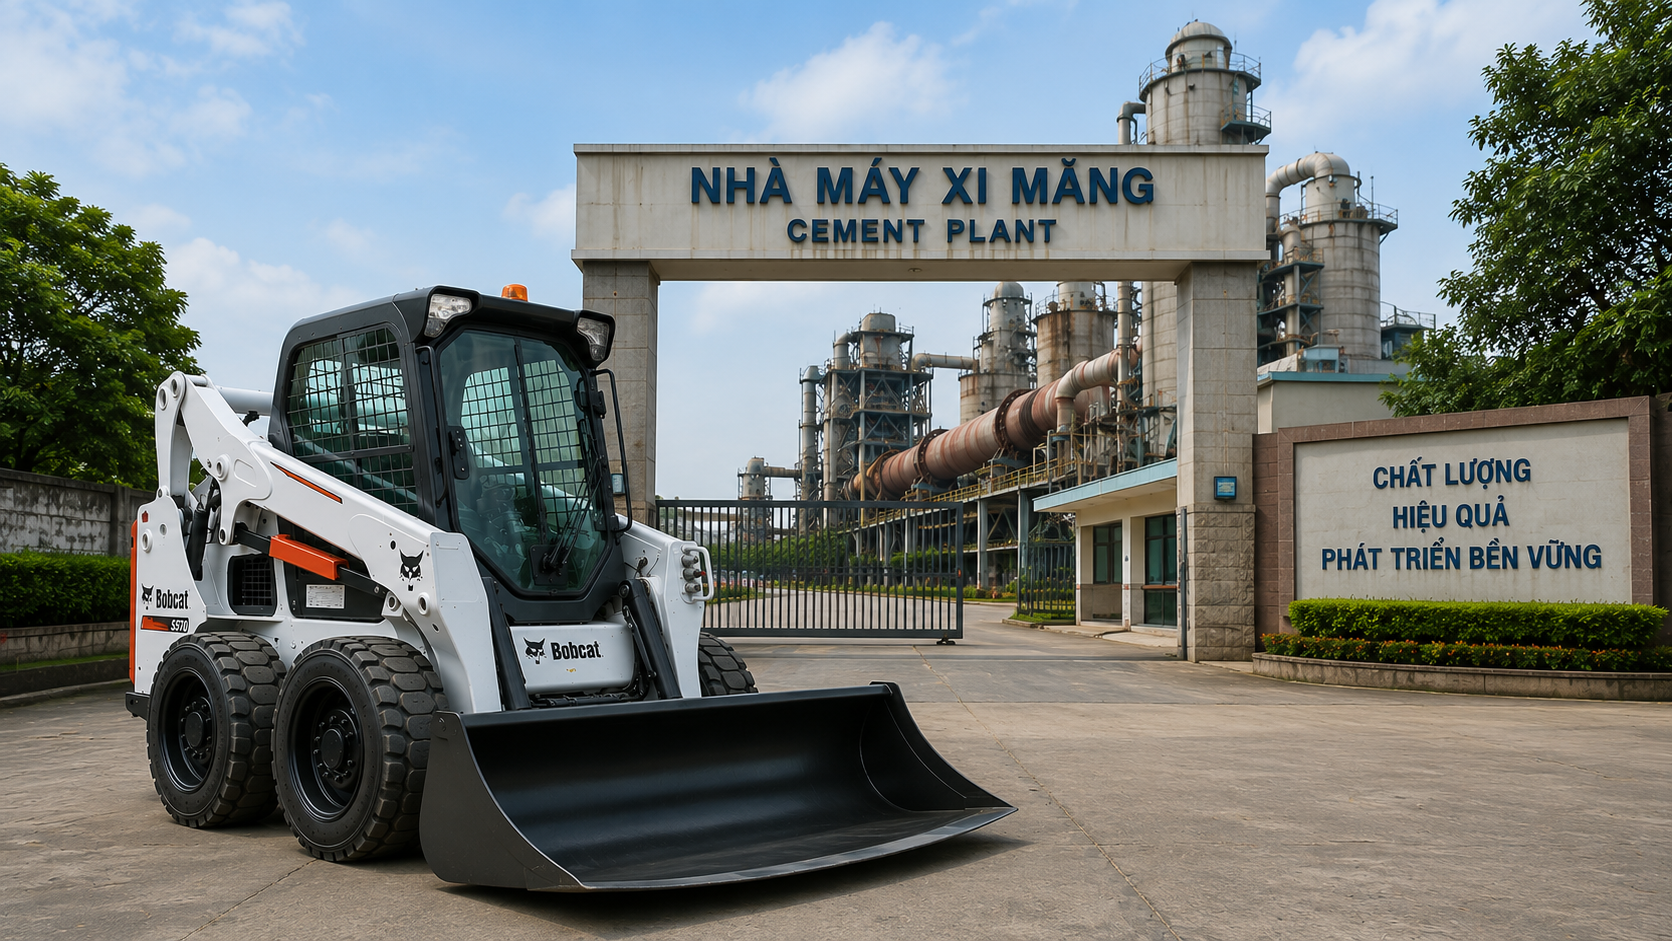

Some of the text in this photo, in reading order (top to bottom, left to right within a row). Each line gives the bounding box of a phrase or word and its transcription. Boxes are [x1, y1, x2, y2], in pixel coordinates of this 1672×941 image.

[691, 156, 1154, 204] NHÀ MÁY XI MĂNG
[787, 218, 1057, 244] CEMENT PLANT
[1373, 456, 1531, 490] CHẤT LƯỢNG
[1392, 495, 1510, 533] HIỆU QUẢ
[1321, 537, 1602, 570] PHÁT TRIỂN BỀN VỮNG
[156, 588, 189, 610] Bobcat
[550, 641, 602, 661] Bobcat
